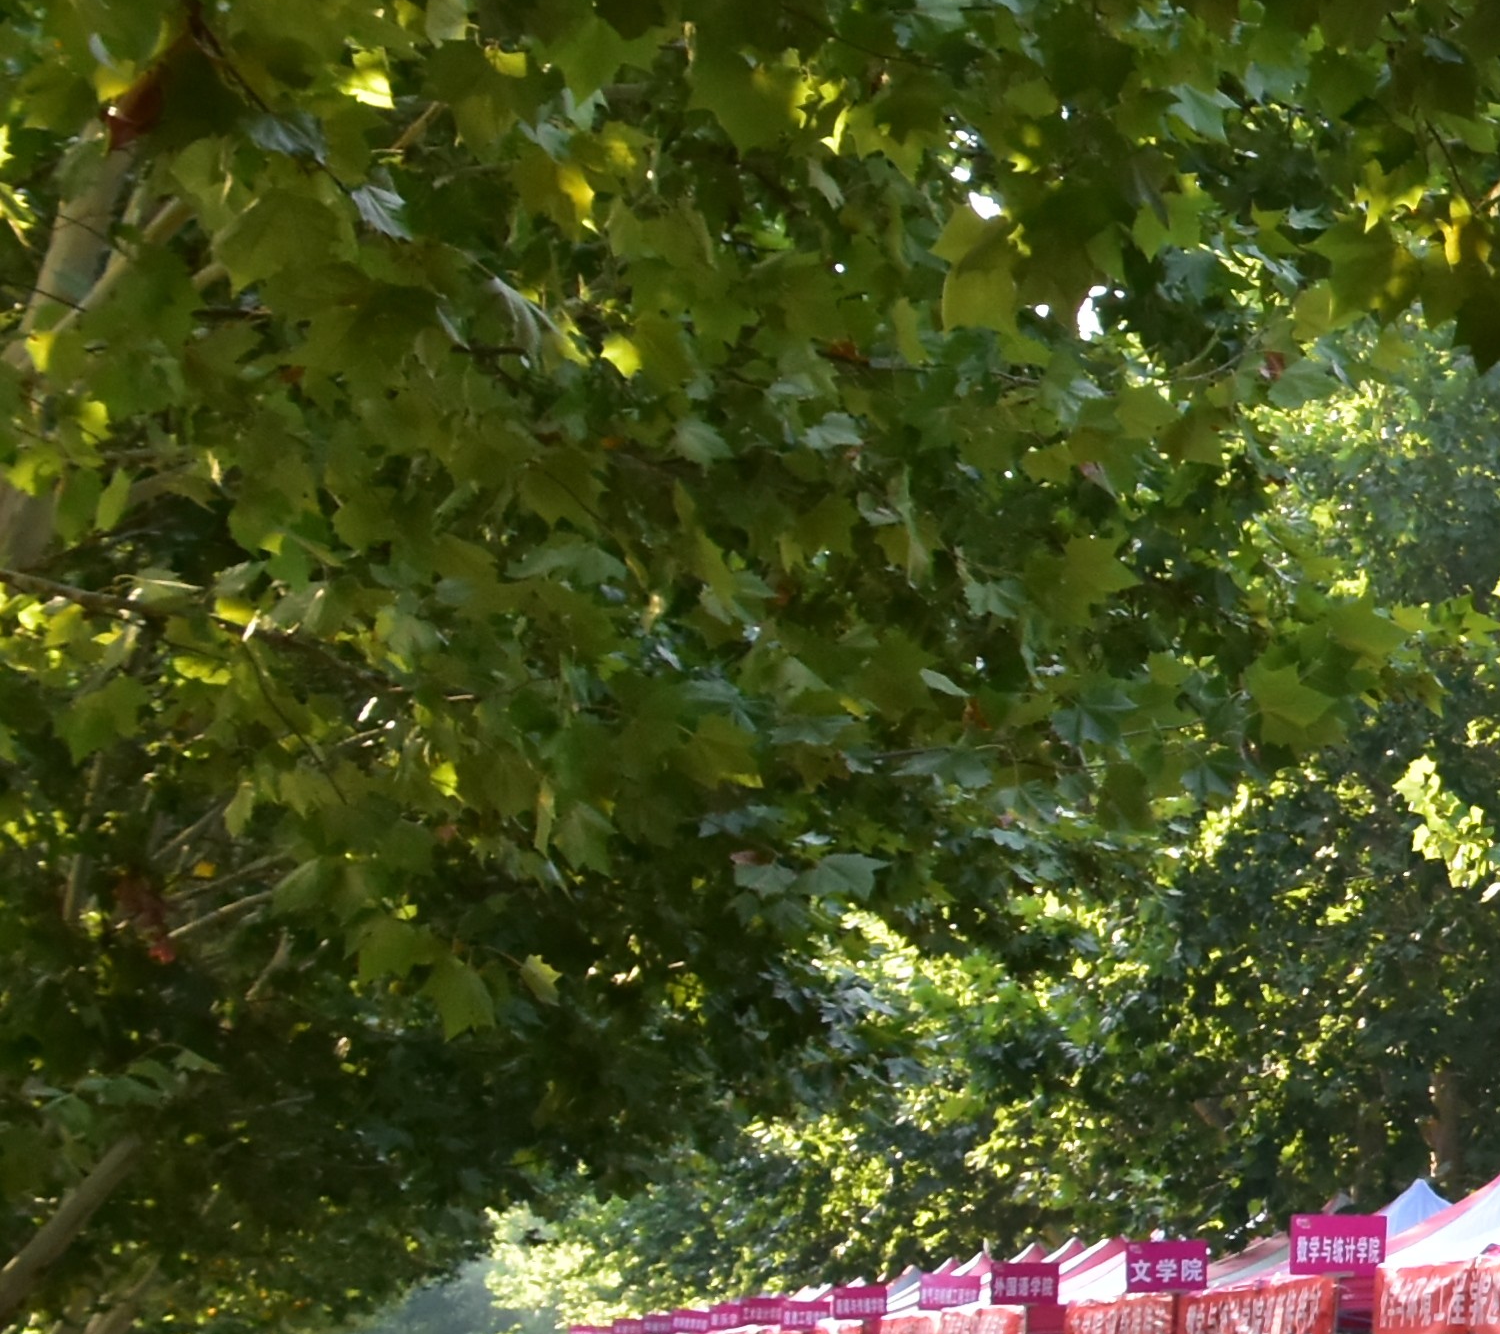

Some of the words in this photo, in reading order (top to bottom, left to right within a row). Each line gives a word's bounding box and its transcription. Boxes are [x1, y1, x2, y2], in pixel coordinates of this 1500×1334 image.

[1296, 1235, 1381, 1264] 数学与统计学院
[1130, 1258, 1204, 1284] 文学院
